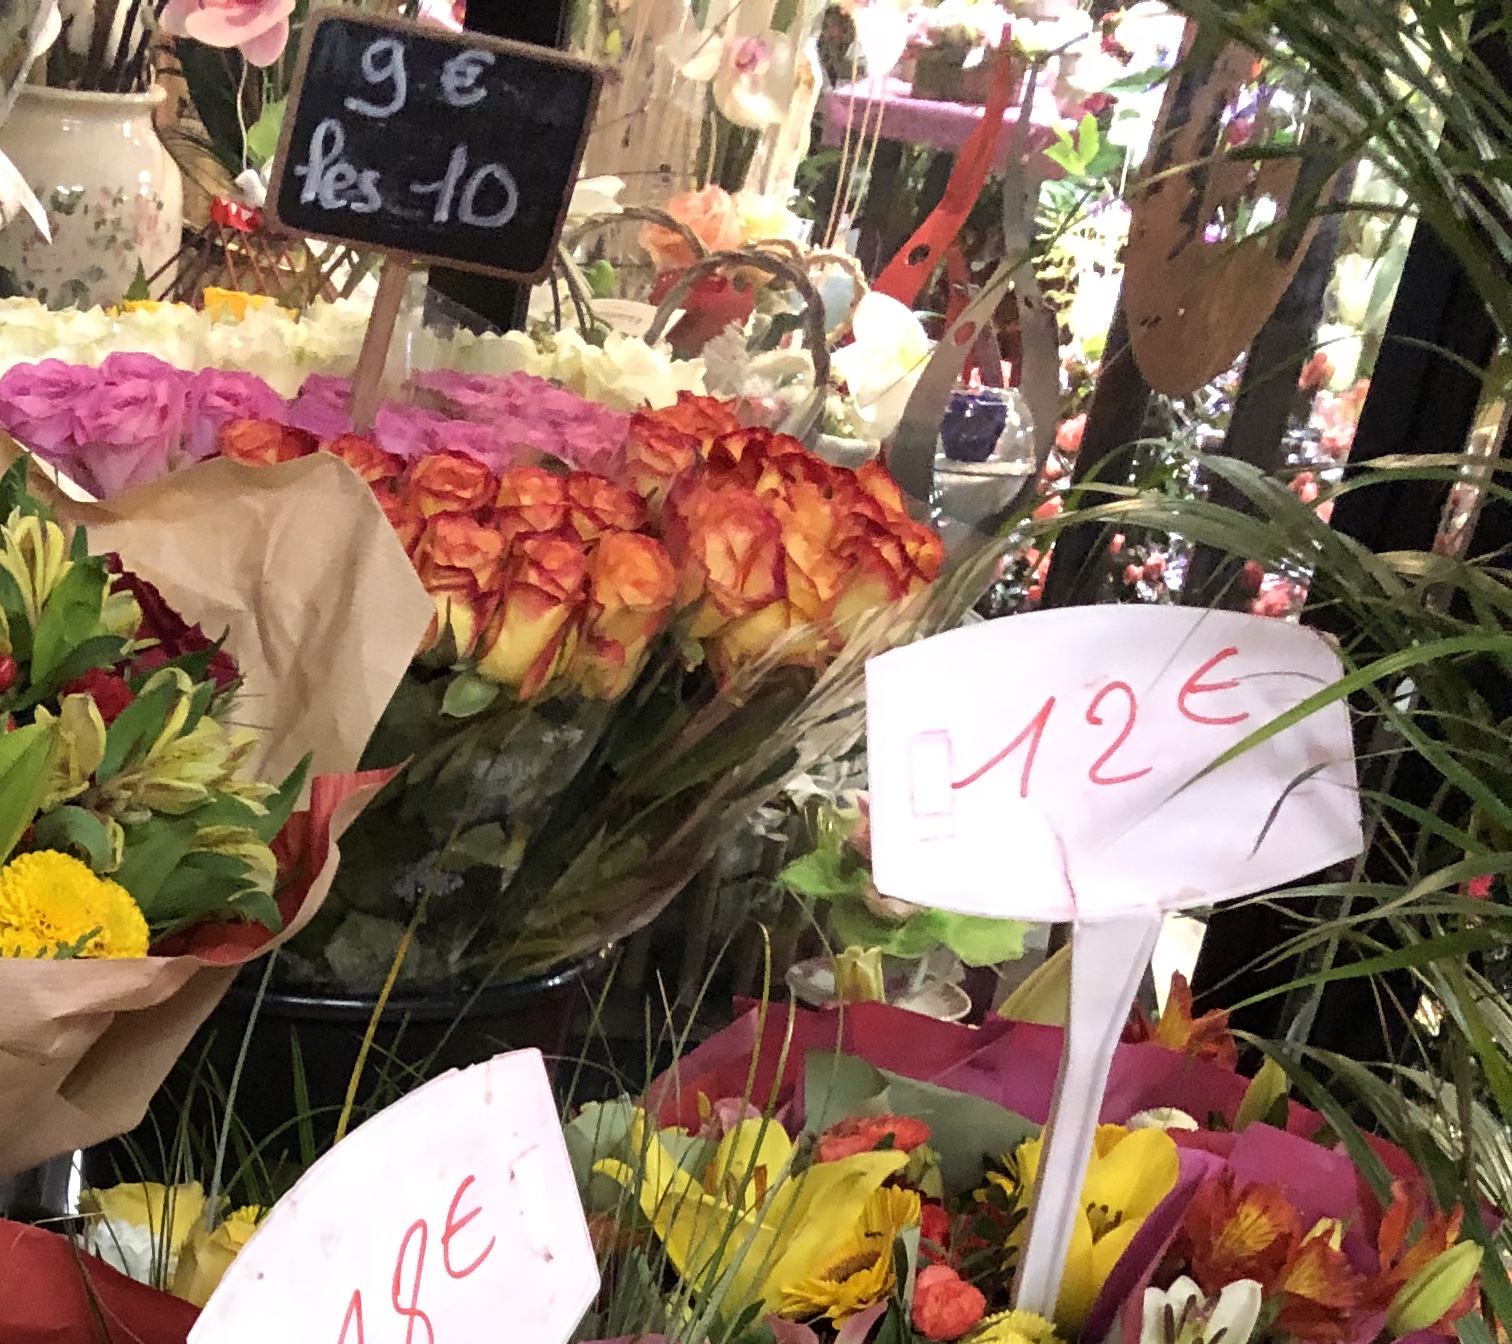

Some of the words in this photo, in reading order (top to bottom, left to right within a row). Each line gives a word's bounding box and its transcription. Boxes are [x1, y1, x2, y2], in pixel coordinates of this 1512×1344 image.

[343, 38, 408, 118] 9
[294, 118, 382, 213] les
[410, 143, 519, 228] 10
